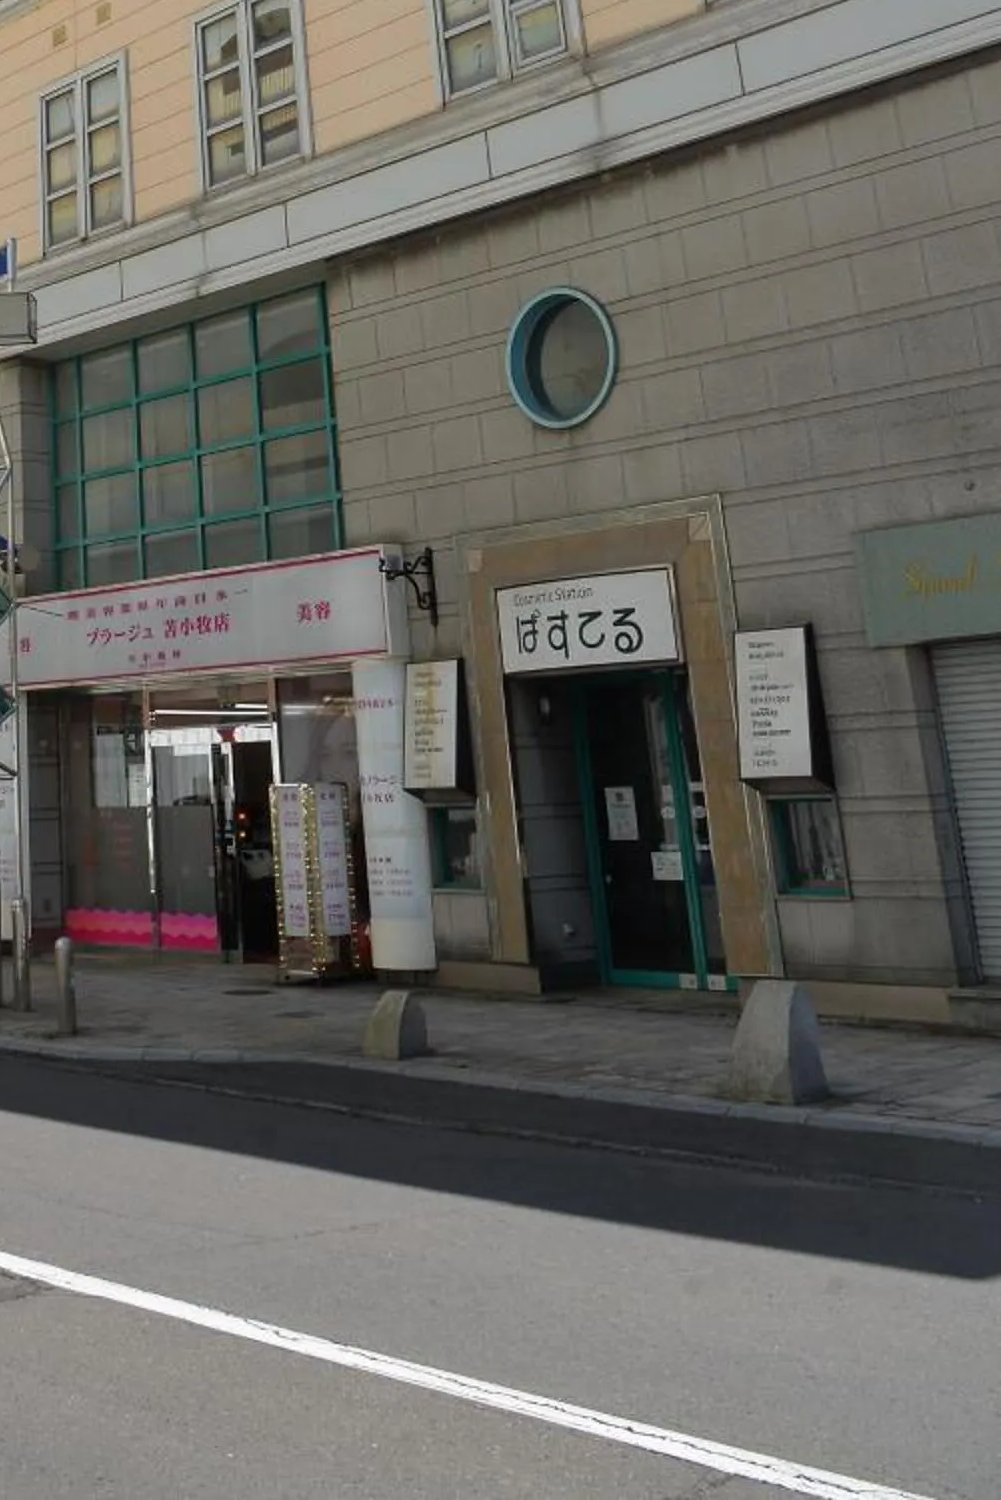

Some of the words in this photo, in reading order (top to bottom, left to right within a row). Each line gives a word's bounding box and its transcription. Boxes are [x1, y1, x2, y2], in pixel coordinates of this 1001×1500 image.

[297, 600, 331, 623] 美容
[516, 608, 644, 660] ぱすてる
